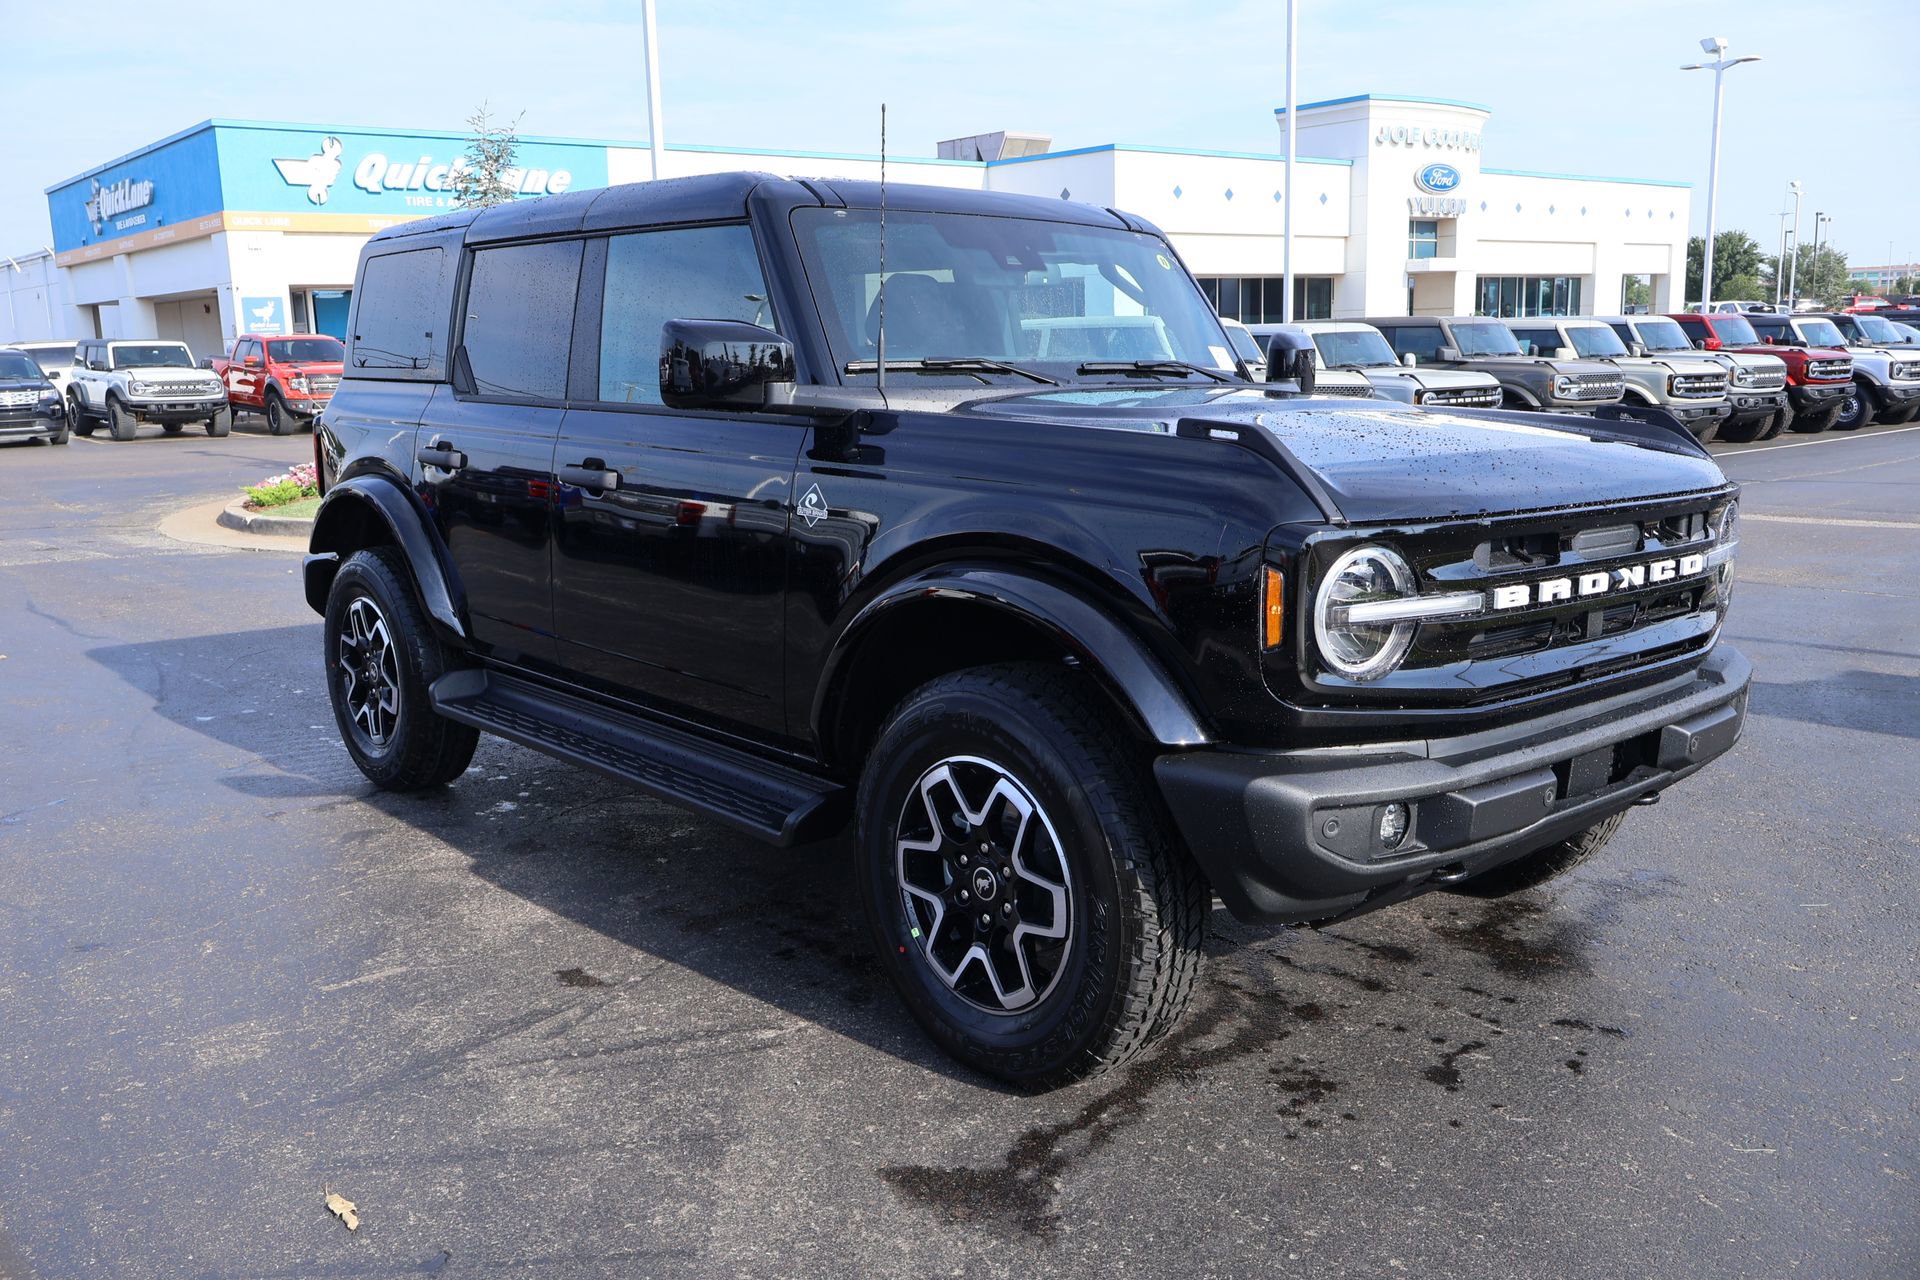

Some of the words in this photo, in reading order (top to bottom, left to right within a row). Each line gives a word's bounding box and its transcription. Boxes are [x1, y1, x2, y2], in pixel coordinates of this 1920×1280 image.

[1377, 126, 1421, 148] JOE
[1424, 128, 1485, 153] COOPER
[353, 152, 472, 194] Quick
[1429, 167, 1455, 187] Ford
[99, 179, 126, 220] Quick
[124, 176, 152, 209] Lane
[404, 195, 433, 207] TIRE
[436, 196, 444, 207] &
[1409, 197, 1467, 216] YUKON
[1493, 552, 1704, 611] BRONCO
